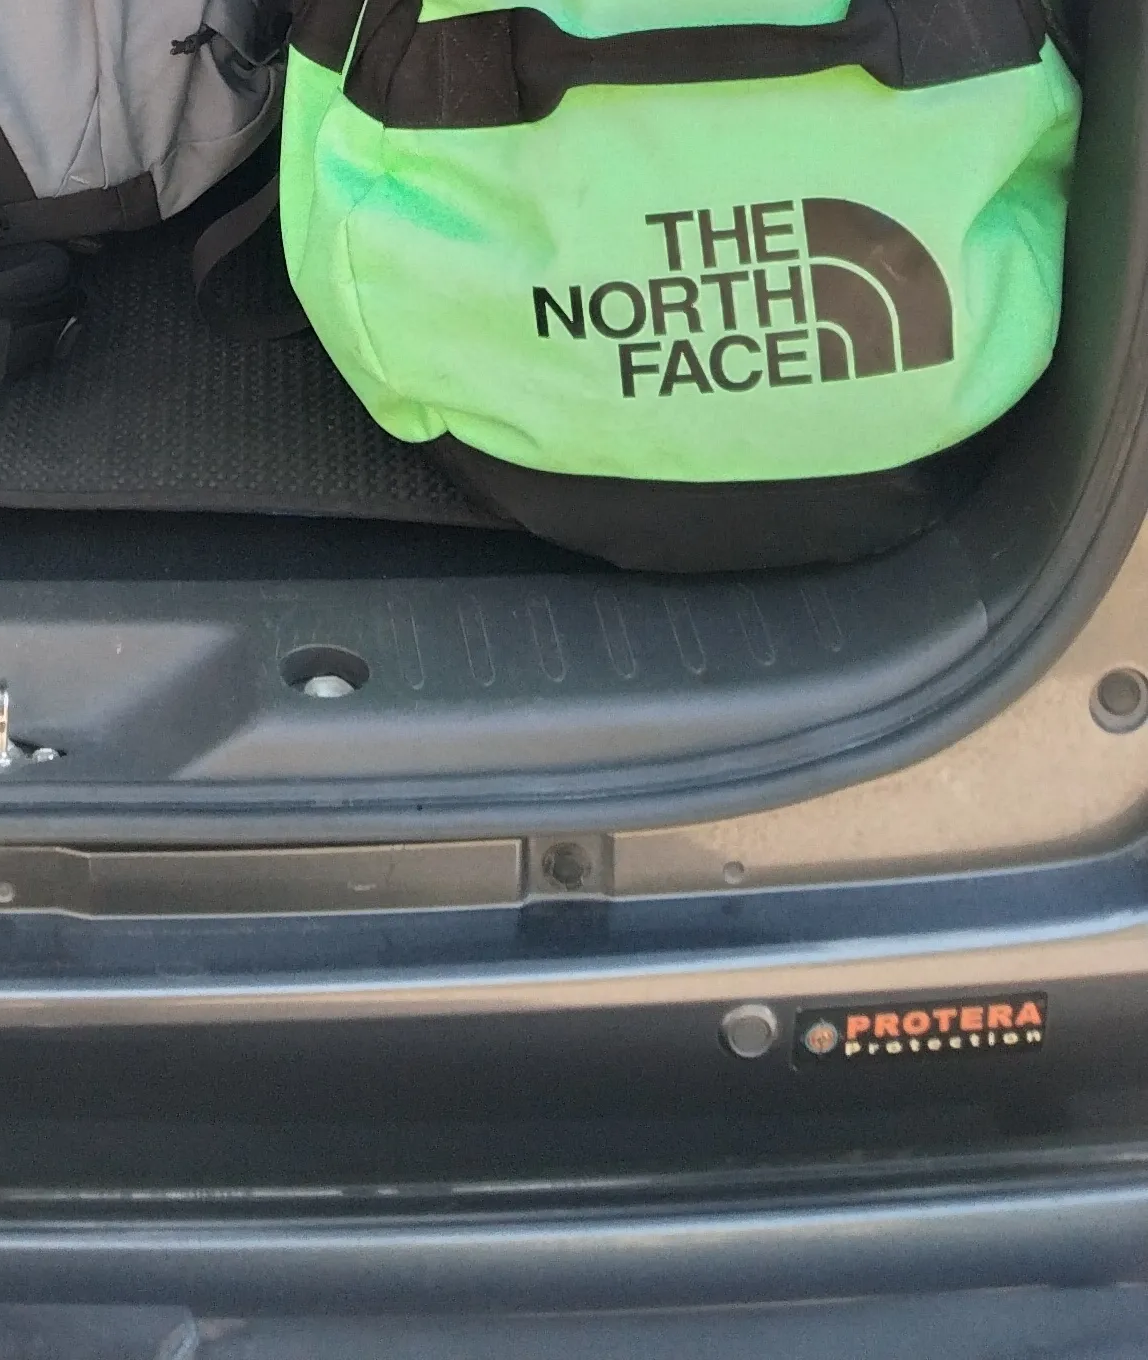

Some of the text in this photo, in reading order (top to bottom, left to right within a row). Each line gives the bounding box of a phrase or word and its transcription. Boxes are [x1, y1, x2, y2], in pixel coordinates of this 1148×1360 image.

[645, 200, 800, 272] THE
[532, 264, 808, 340] NORTH
[618, 329, 813, 399] FACE
[846, 1000, 1042, 1040] PROTERA
